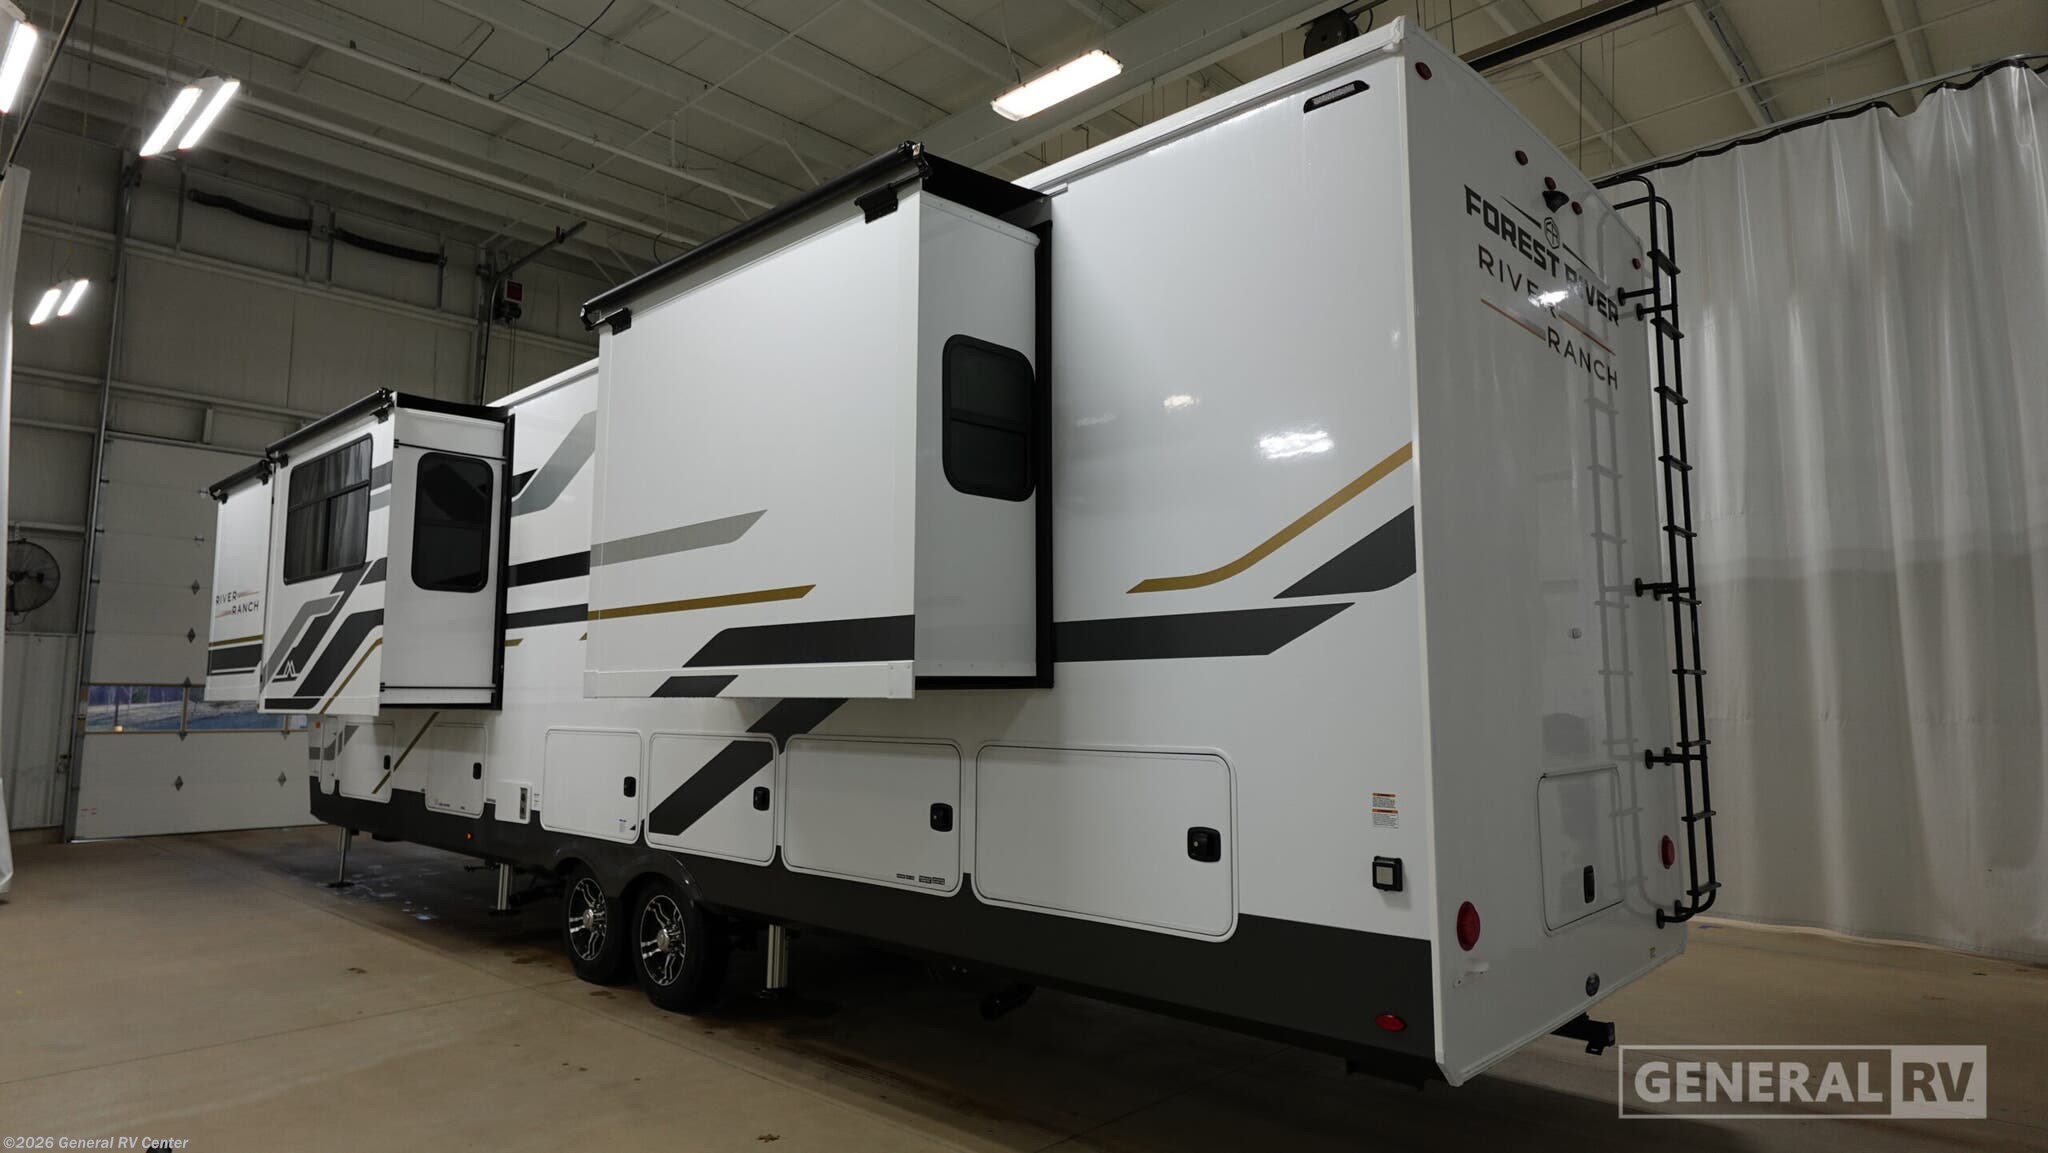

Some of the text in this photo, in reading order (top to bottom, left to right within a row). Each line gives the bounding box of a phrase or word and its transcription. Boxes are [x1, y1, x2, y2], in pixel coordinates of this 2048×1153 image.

[1463, 184, 1560, 278] FOREST
[1547, 326, 1618, 390] RANCH
[216, 590, 237, 604] RIVER
[232, 600, 260, 615] RANCH
